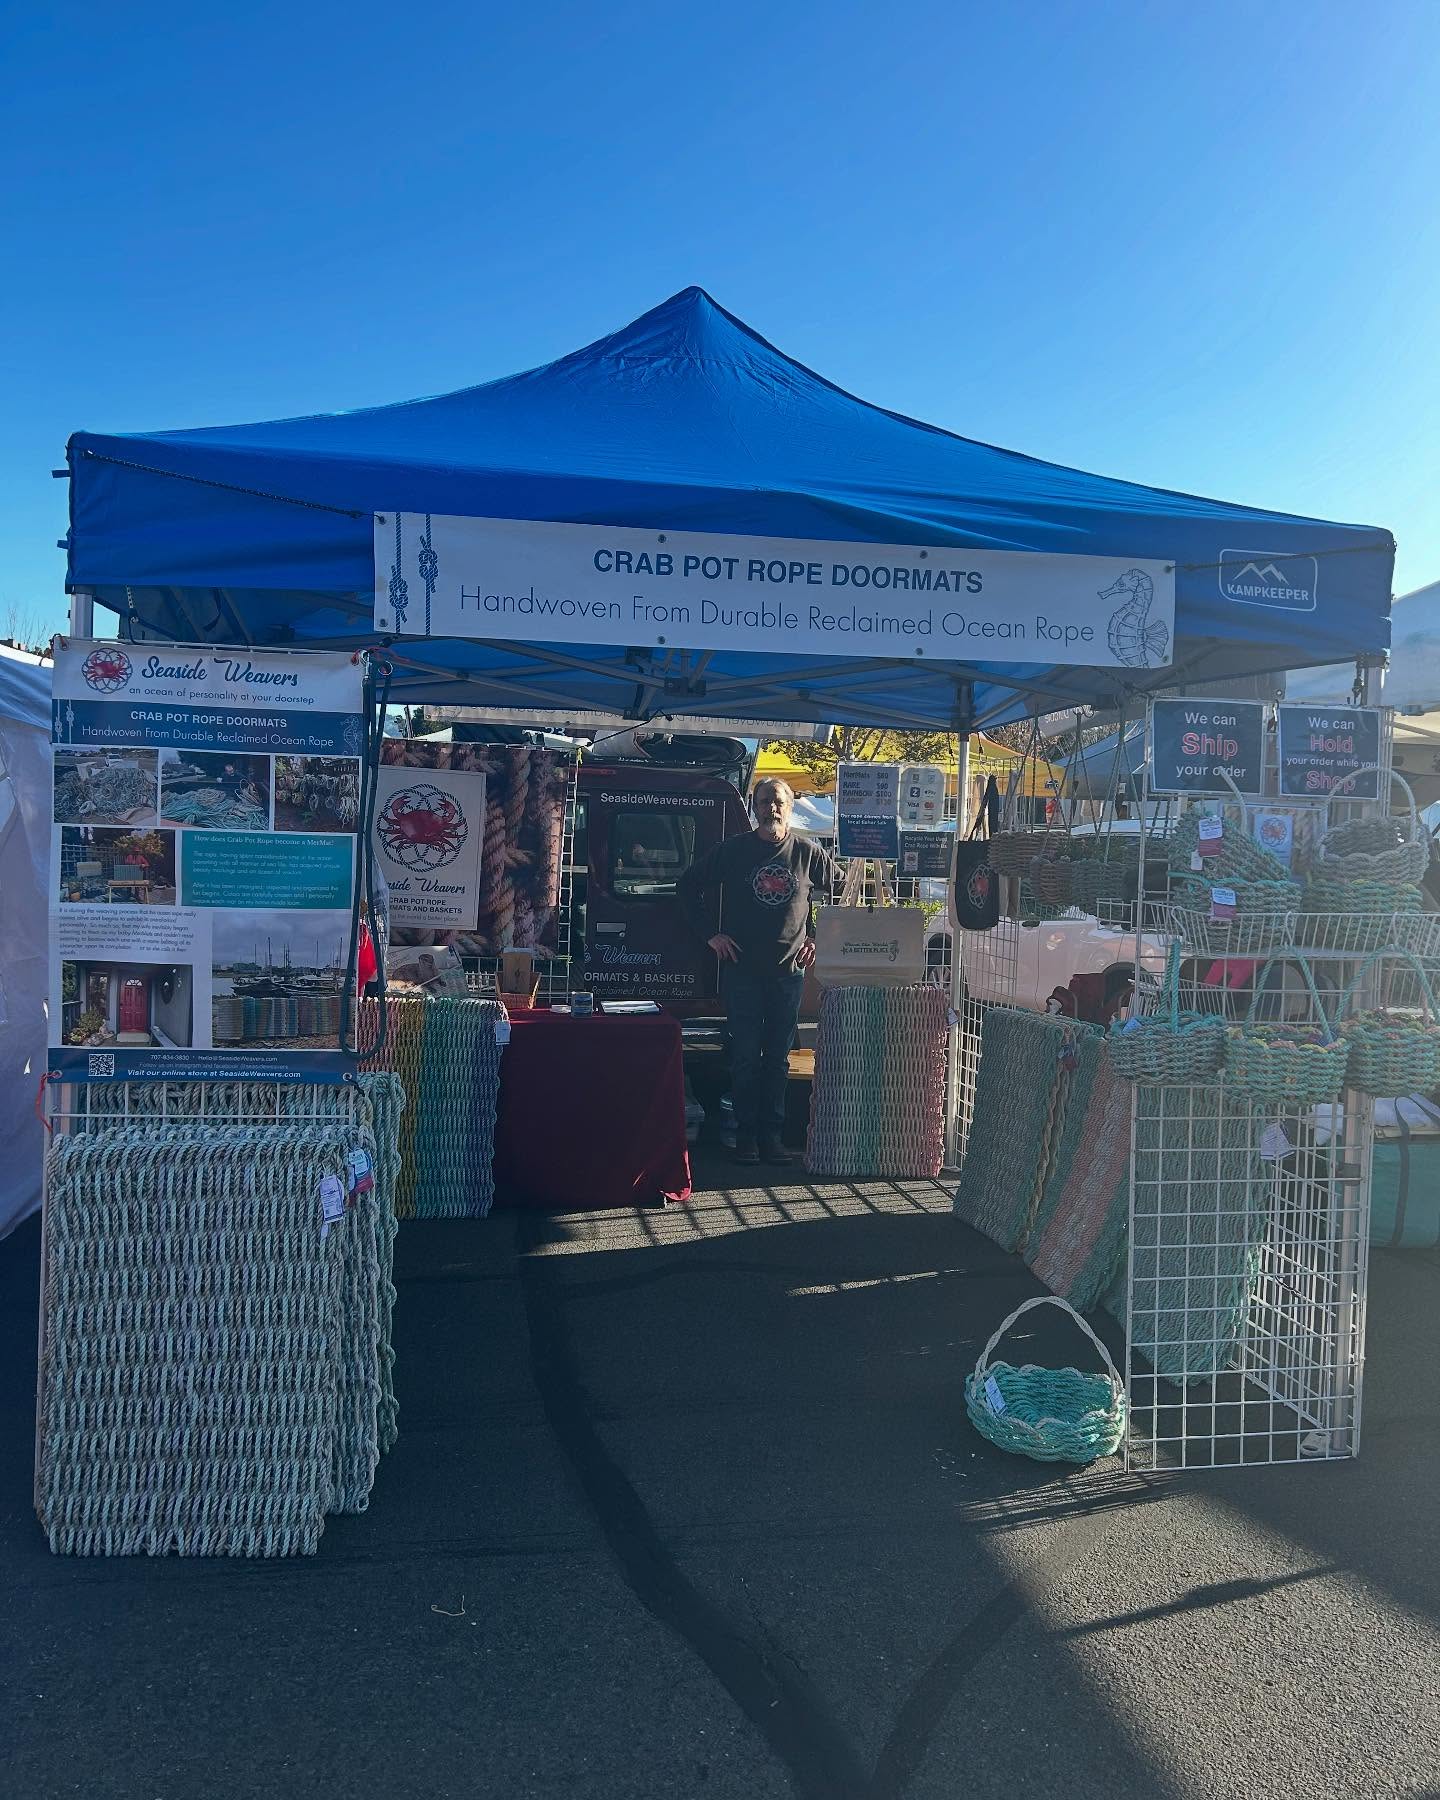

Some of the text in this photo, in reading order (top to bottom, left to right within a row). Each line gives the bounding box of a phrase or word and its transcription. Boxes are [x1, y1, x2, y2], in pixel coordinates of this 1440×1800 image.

[594, 549, 983, 593] CRAB POT ROPE DOORMATS
[1226, 584, 1309, 602] KAMPKEEPER
[460, 585, 1095, 643] Handwoven From Durable Reclaimed Ocean Rope
[142, 655, 299, 687] Seaside Weavers
[144, 689, 174, 697] ocean
[176, 687, 186, 697] of
[189, 690, 237, 704] personality
[240, 693, 250, 701] at
[252, 695, 272, 704] your
[274, 694, 314, 706] doorstep
[130, 710, 287, 728] CRAB POT ROPE DOORMATS
[1185, 712, 1237, 726] We can
[1308, 716, 1355, 730] We can
[82, 725, 334, 748] Handwoven From Durable Reclaimed Ocean Rope
[1310, 735, 1353, 754] Hold
[1181, 732, 1238, 760] Ship
[1286, 758, 1308, 768] your
[1310, 756, 1335, 767] order
[1336, 758, 1359, 768] while
[1176, 766, 1209, 778] your
[1306, 771, 1356, 793] Shop
[600, 792, 715, 807] SeasideWeavers.com
[414, 877, 466, 894] Weavers
[429, 906, 463, 914] BASKETS
[594, 943, 662, 966] Weavers
[583, 972, 695, 984] ORMATS & BASKETS
[592, 985, 636, 995] Reclaimed
[638, 986, 667, 996] Ocean
[162, 1069, 186, 1077] online
[219, 1070, 301, 1078] SeasideWeavers.com
